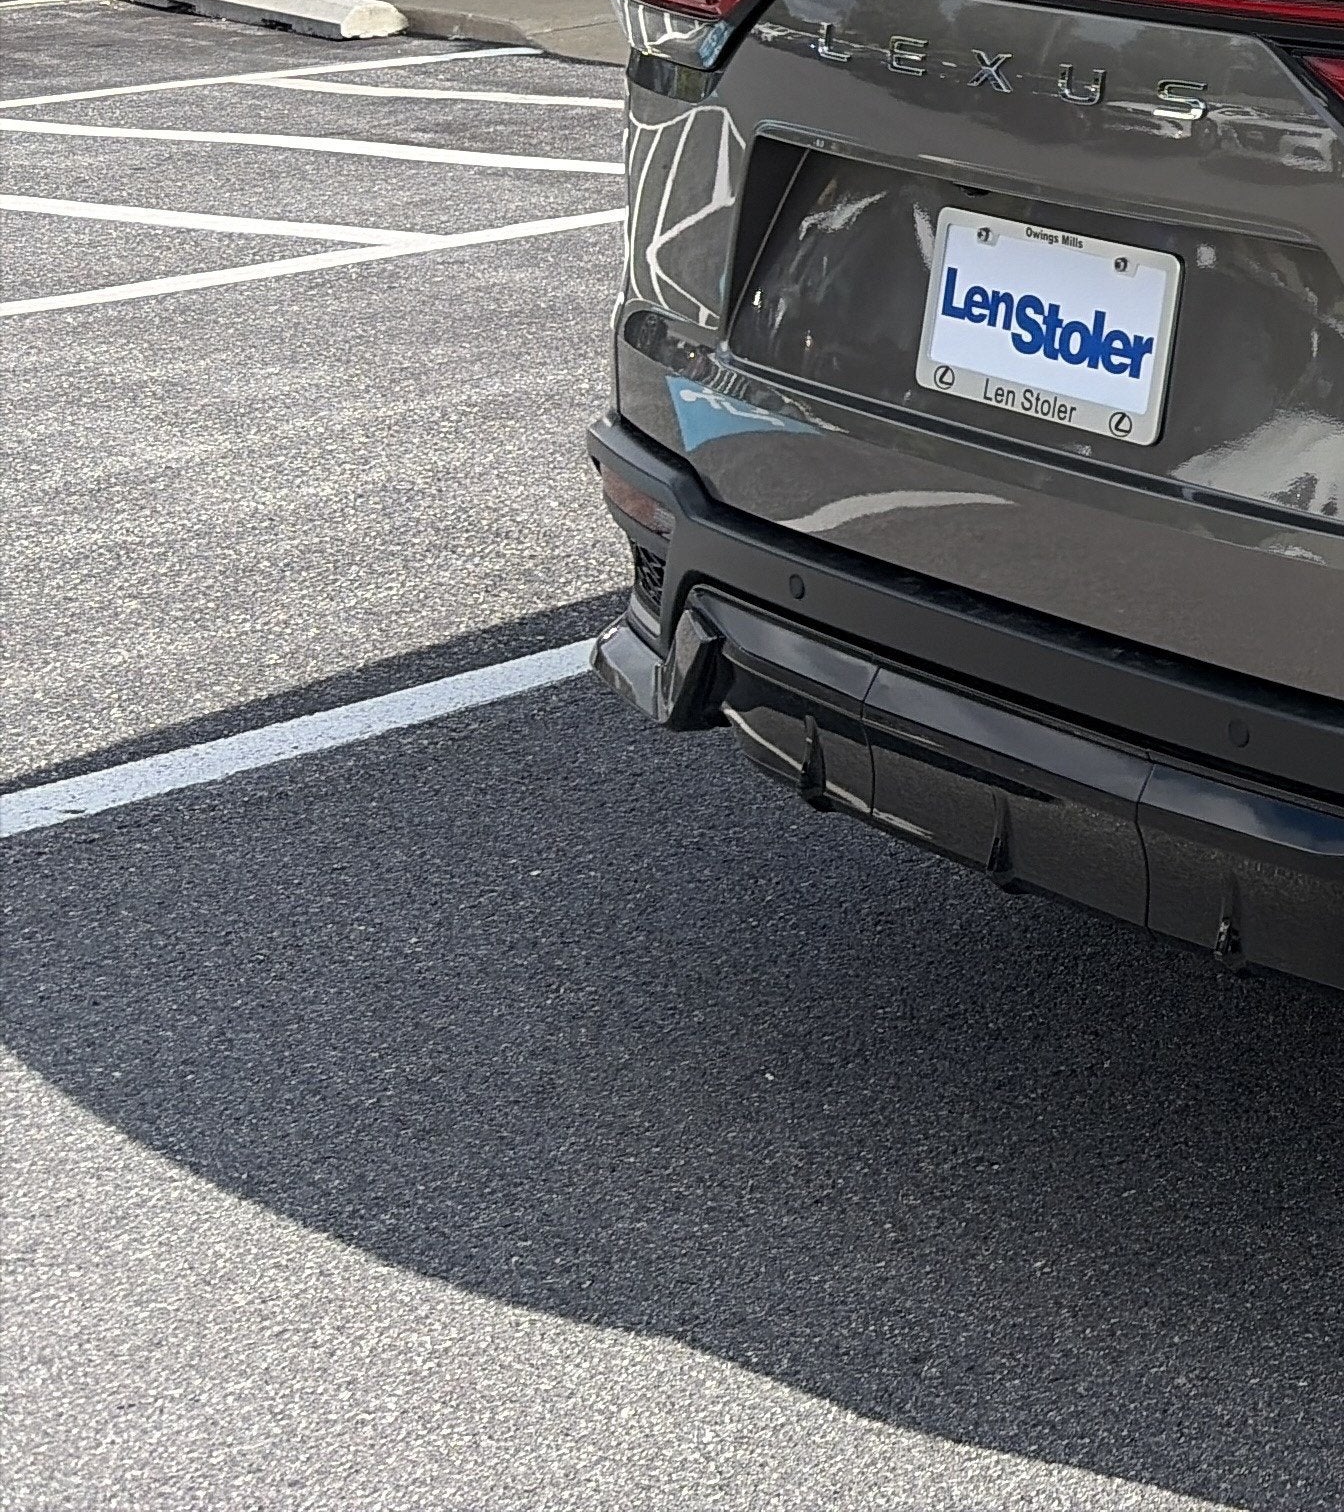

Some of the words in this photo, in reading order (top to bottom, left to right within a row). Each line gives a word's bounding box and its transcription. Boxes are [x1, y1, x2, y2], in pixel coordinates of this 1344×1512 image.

[818, 21, 1208, 120] LEXUS
[1025, 227, 1059, 244] Owings
[1061, 234, 1084, 249] Mills
[983, 378, 1016, 408] Len
[1021, 388, 1077, 423] Stoler
